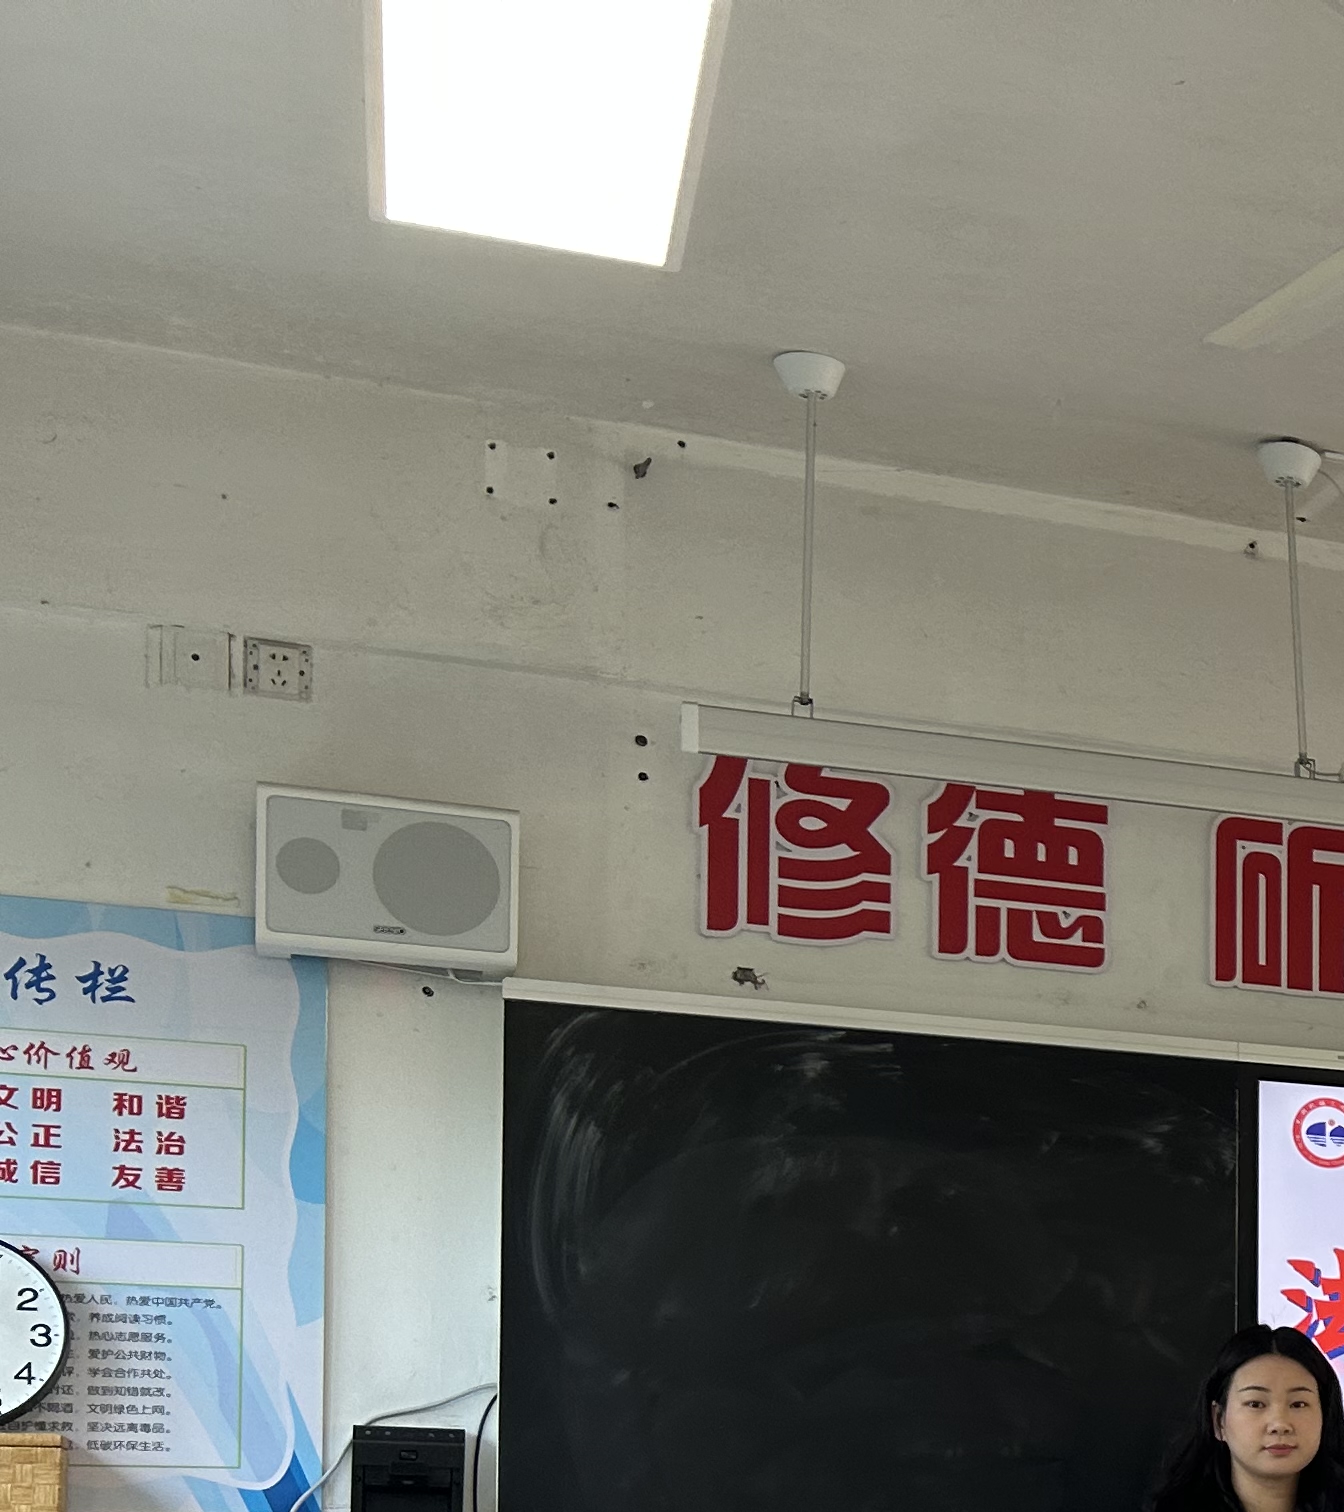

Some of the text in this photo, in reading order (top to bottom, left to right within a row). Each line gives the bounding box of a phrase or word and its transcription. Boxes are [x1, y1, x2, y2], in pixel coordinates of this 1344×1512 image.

[697, 754, 1110, 972] 修德
[111, 1091, 188, 1121] 和谐
[112, 1127, 187, 1157] 法治
[111, 1164, 187, 1193] 友善
[16, 1287, 40, 1312] 2
[29, 1322, 53, 1348] 3
[13, 1361, 37, 1385] 4
